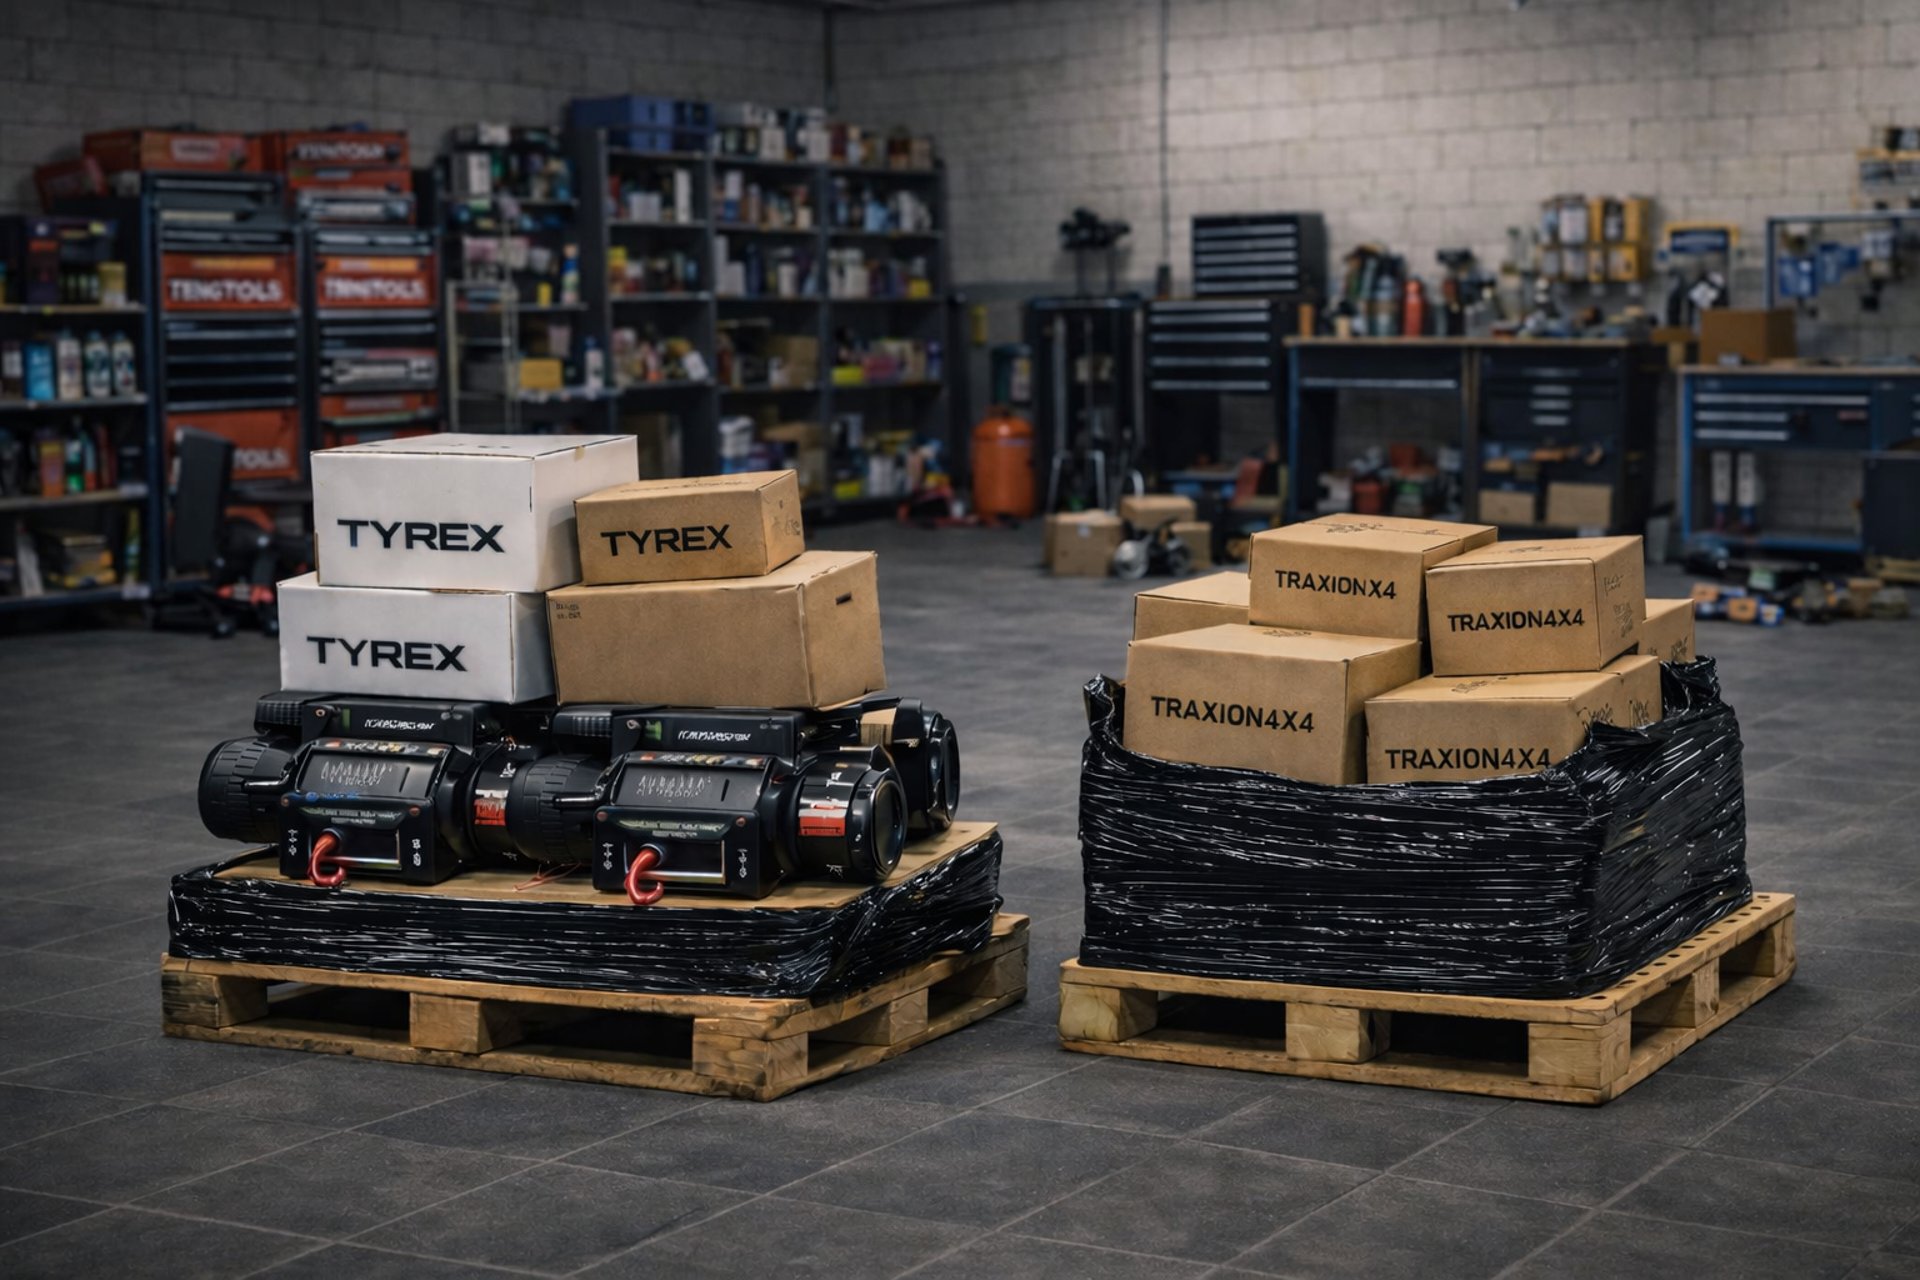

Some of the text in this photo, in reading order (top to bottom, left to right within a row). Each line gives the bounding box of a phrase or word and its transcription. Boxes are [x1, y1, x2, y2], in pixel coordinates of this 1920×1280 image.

[337, 519, 505, 553] TYREX
[600, 524, 732, 557] TYREX
[1275, 570, 1397, 599] TRAXIONX4
[1447, 608, 1585, 632] TRAXION4X4
[307, 636, 467, 672] TYREX
[1151, 695, 1314, 733] TRAXION4X4
[1385, 747, 1551, 770] TRAXION4X4
